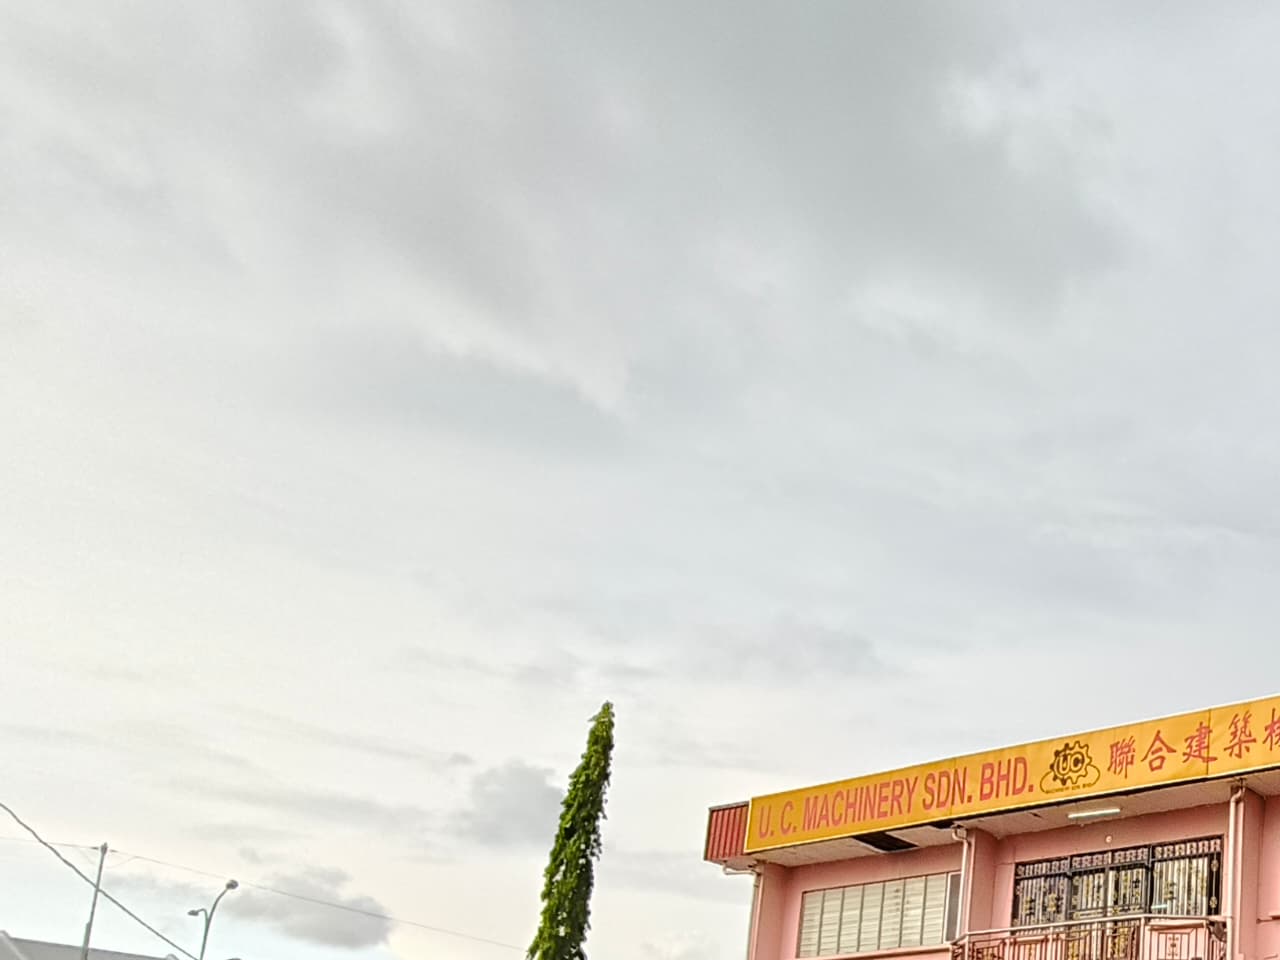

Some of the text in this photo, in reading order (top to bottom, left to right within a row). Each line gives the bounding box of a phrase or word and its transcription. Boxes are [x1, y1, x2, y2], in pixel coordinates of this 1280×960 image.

[1055, 751, 1085, 776] UC
[758, 756, 1034, 839] U. C. MACHINERY SDN. BHD.
